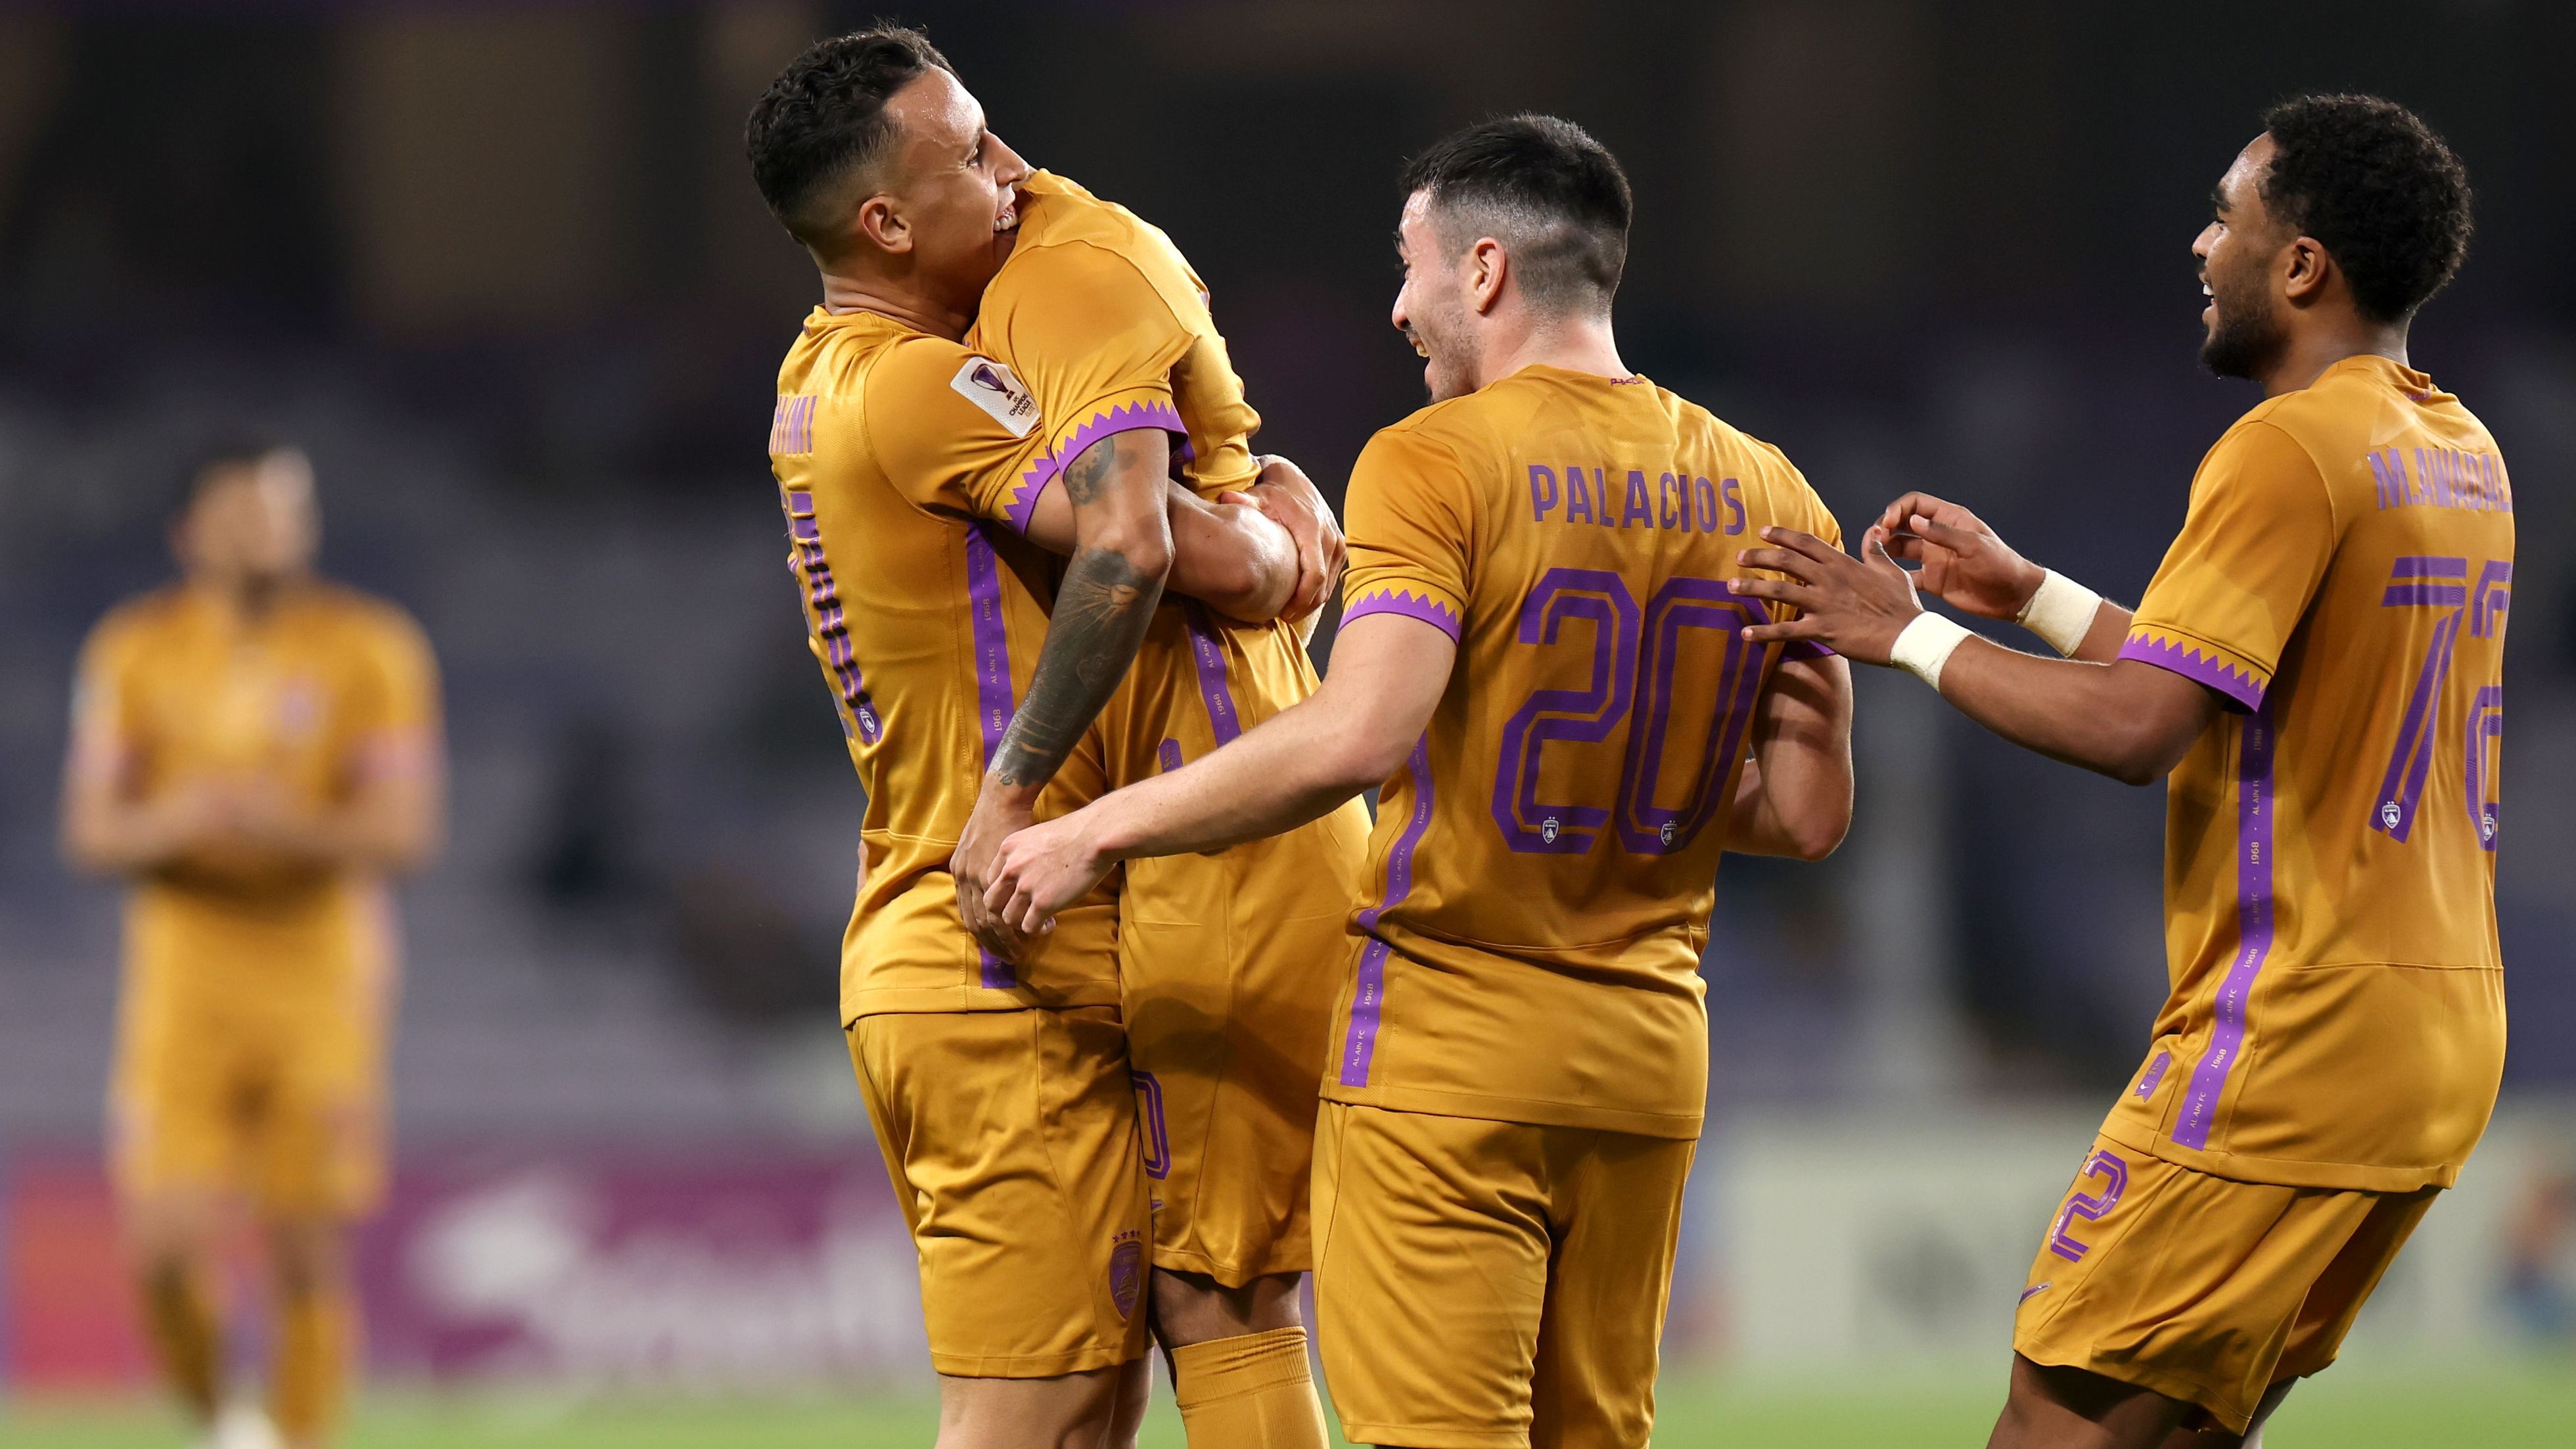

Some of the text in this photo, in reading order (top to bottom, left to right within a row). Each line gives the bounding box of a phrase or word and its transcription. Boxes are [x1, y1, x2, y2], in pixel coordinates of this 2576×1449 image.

[1017, 400, 1032, 415] LEAGUE
[1529, 465, 1745, 535] PALACIOS
[982, 598, 992, 620] 1968
[1208, 657, 1215, 668] AL
[991, 676, 998, 684] AL
[1213, 693, 1225, 716] 1968
[1491, 568, 1771, 854] 20
[2369, 555, 2512, 852] 72
[993, 709, 1002, 731] 1968
[2253, 805, 2259, 816] AL
[2251, 842, 2259, 865] 1968
[2251, 892, 2259, 901] FC
[2229, 988, 2238, 998] FC
[1352, 1057, 1360, 1067] AL
[1358, 1030, 1366, 1040] FC
[1364, 983, 1373, 1006] 1968
[1372, 949, 1380, 957] AL
[2226, 1000, 2234, 1013] AIN
[2210, 1048, 2228, 1069] 1968
[2198, 1092, 2207, 1102] FC
[2193, 1103, 2203, 1117] AIN
[2190, 1119, 2198, 1128] AL
[2050, 1149, 2128, 1263] 2
